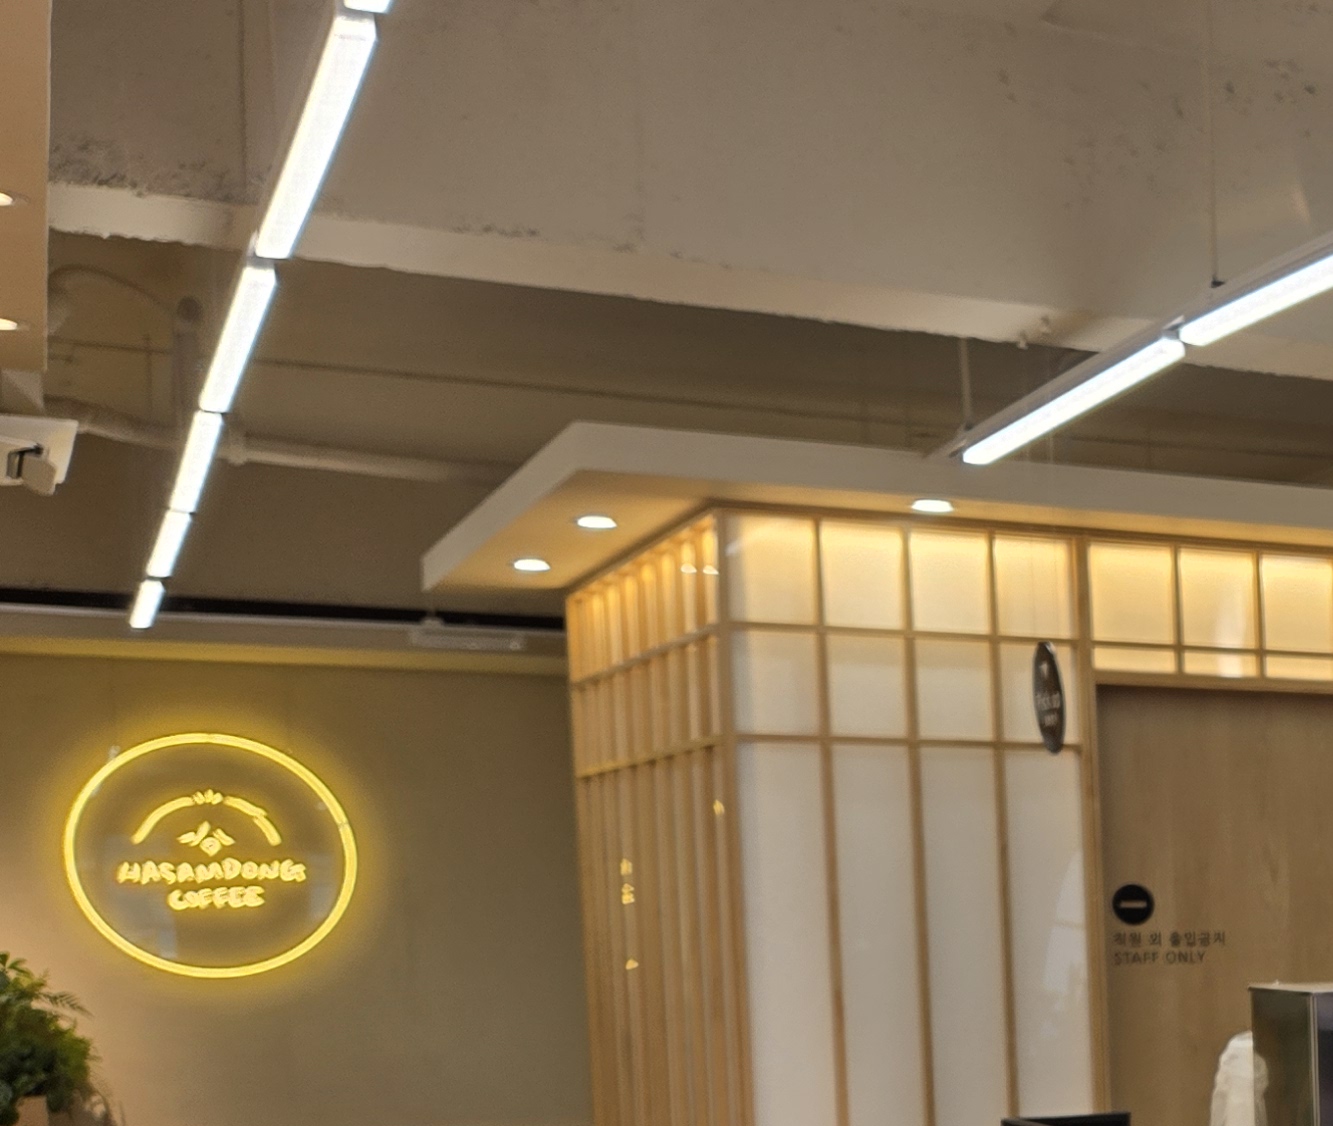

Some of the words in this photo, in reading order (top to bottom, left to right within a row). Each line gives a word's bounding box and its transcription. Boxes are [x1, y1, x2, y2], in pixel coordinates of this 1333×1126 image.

[167, 885, 265, 911] COFFEE
[1113, 951, 1159, 966] STAFF
[1165, 950, 1206, 965] ONLY
